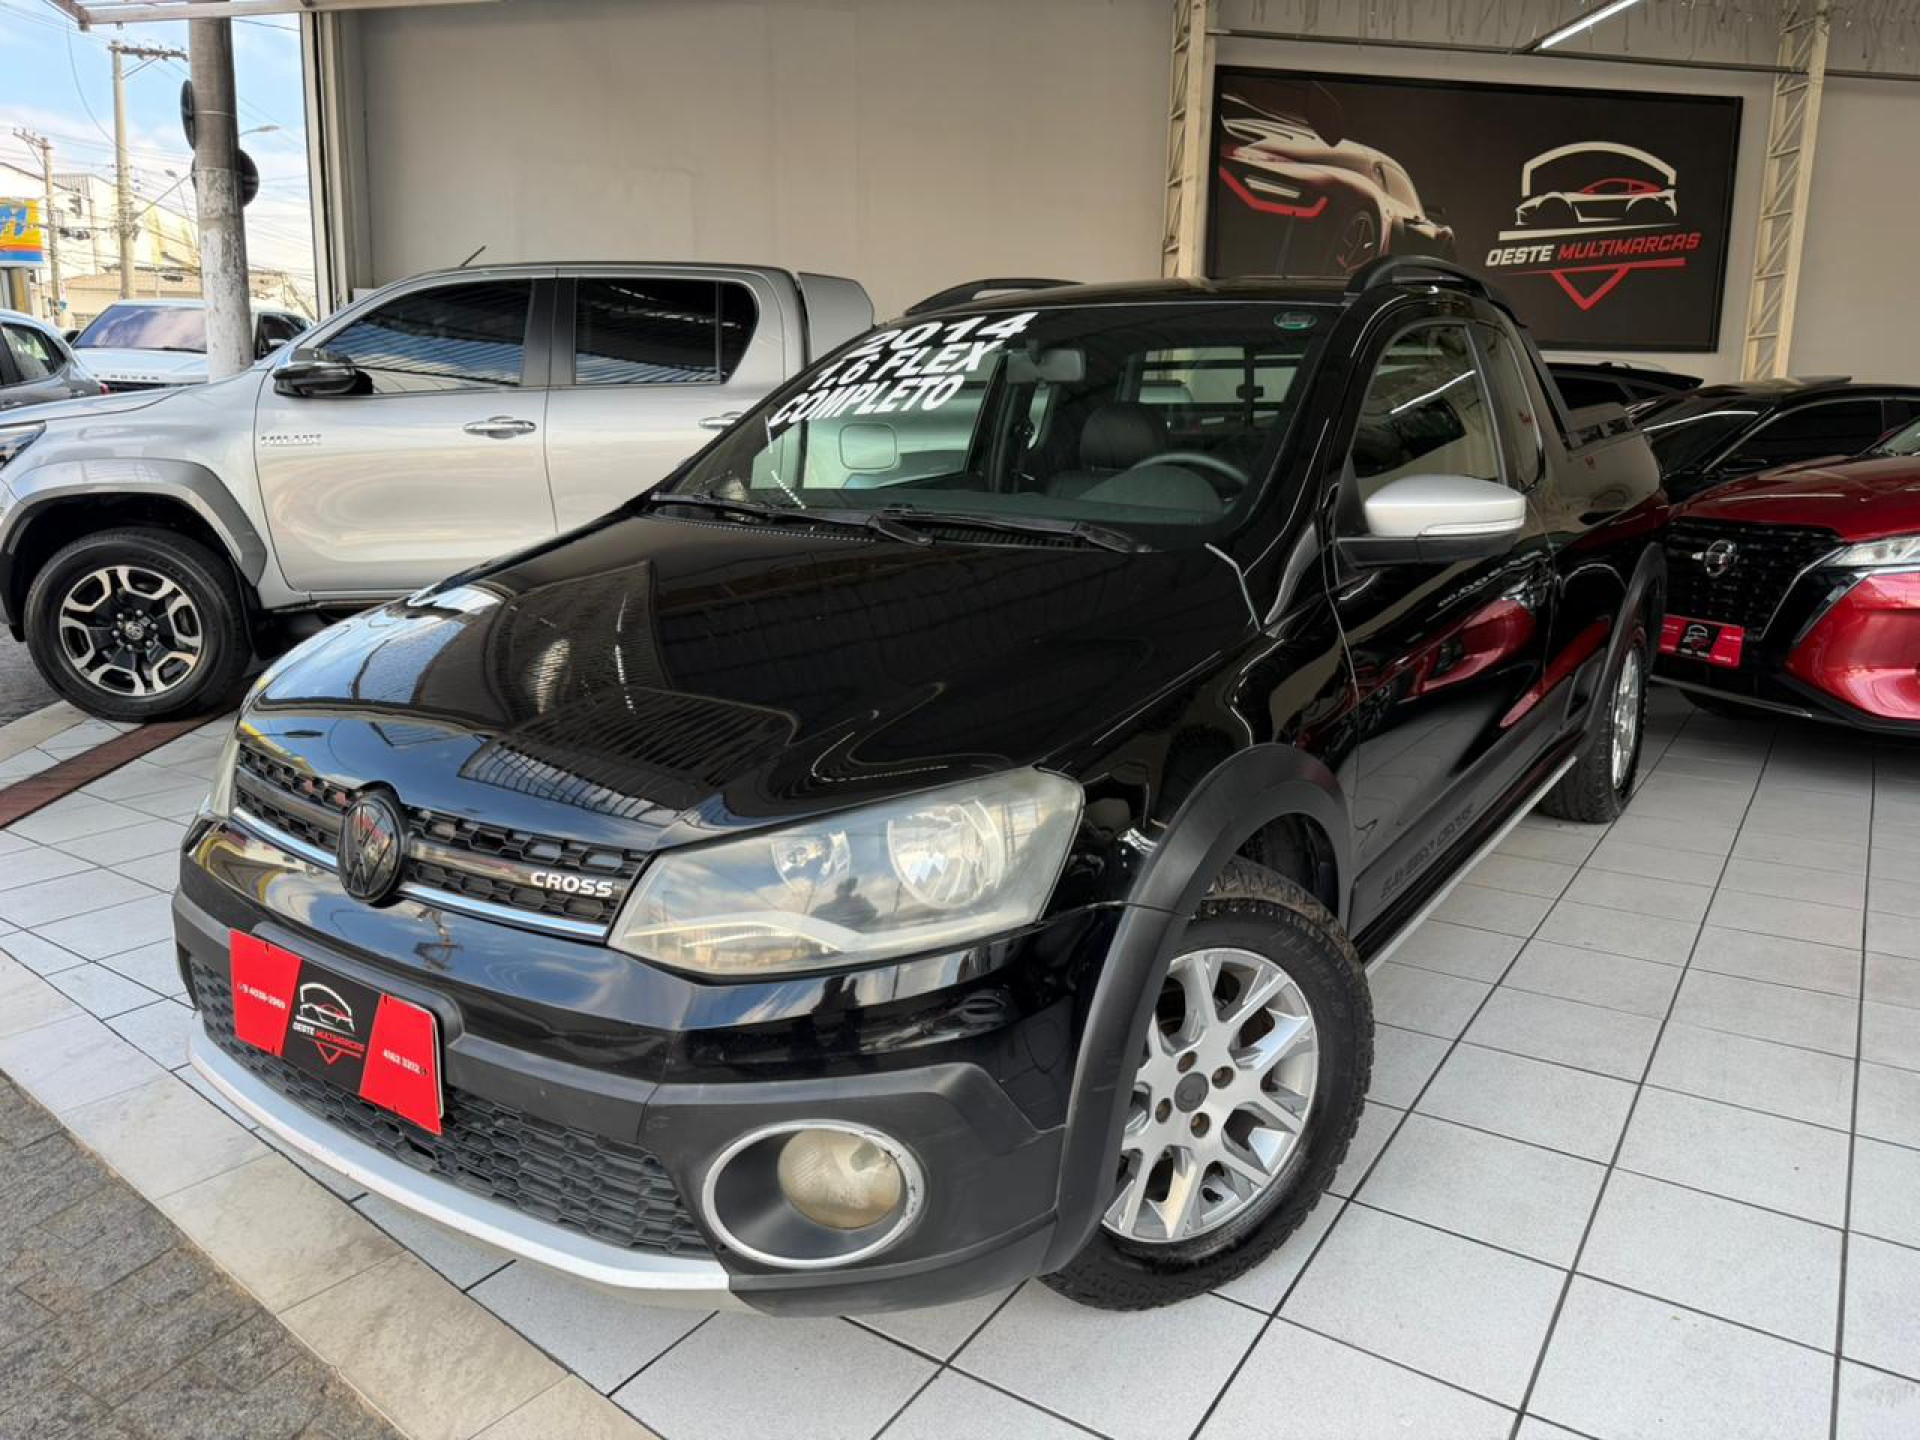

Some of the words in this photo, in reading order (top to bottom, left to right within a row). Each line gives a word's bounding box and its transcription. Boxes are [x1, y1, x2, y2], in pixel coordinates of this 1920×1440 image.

[1485, 244, 1555, 267] OESTE
[1558, 233, 1702, 260] MULTIMARCAS
[843, 311, 1039, 360] 2014
[807, 353, 880, 391] 1.6
[871, 340, 1005, 382] FLEX
[768, 374, 966, 428] COMPLETO
[530, 870, 613, 898] CROSS
